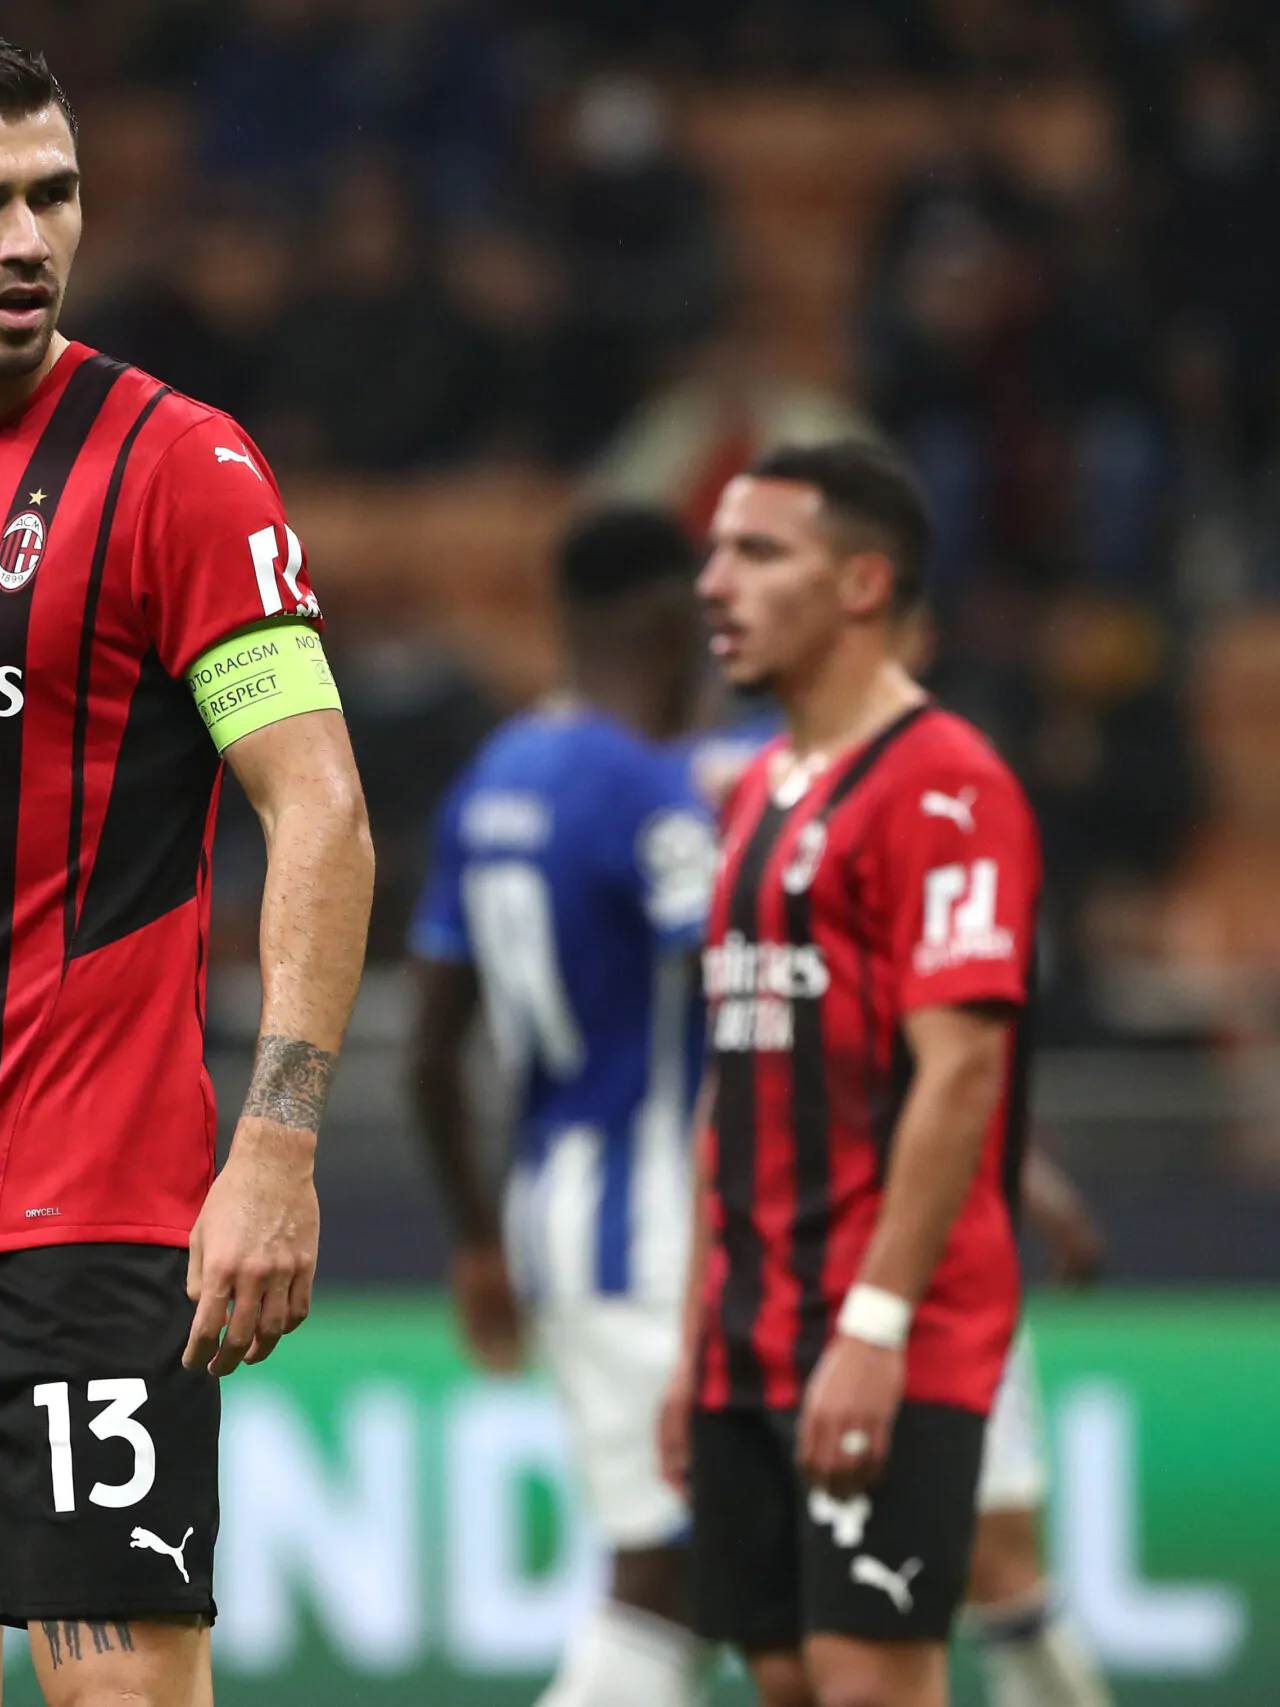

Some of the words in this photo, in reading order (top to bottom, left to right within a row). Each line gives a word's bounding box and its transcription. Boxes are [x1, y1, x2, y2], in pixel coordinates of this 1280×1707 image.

[14, 516, 40, 531] ACM
[0, 572, 24, 584] 1899
[194, 669, 213, 688] TO
[214, 642, 279, 678] RACISM
[210, 674, 277, 717] RESPECT
[25, 1207, 62, 1218] DRYCELL
[33, 1378, 156, 1513] 13
